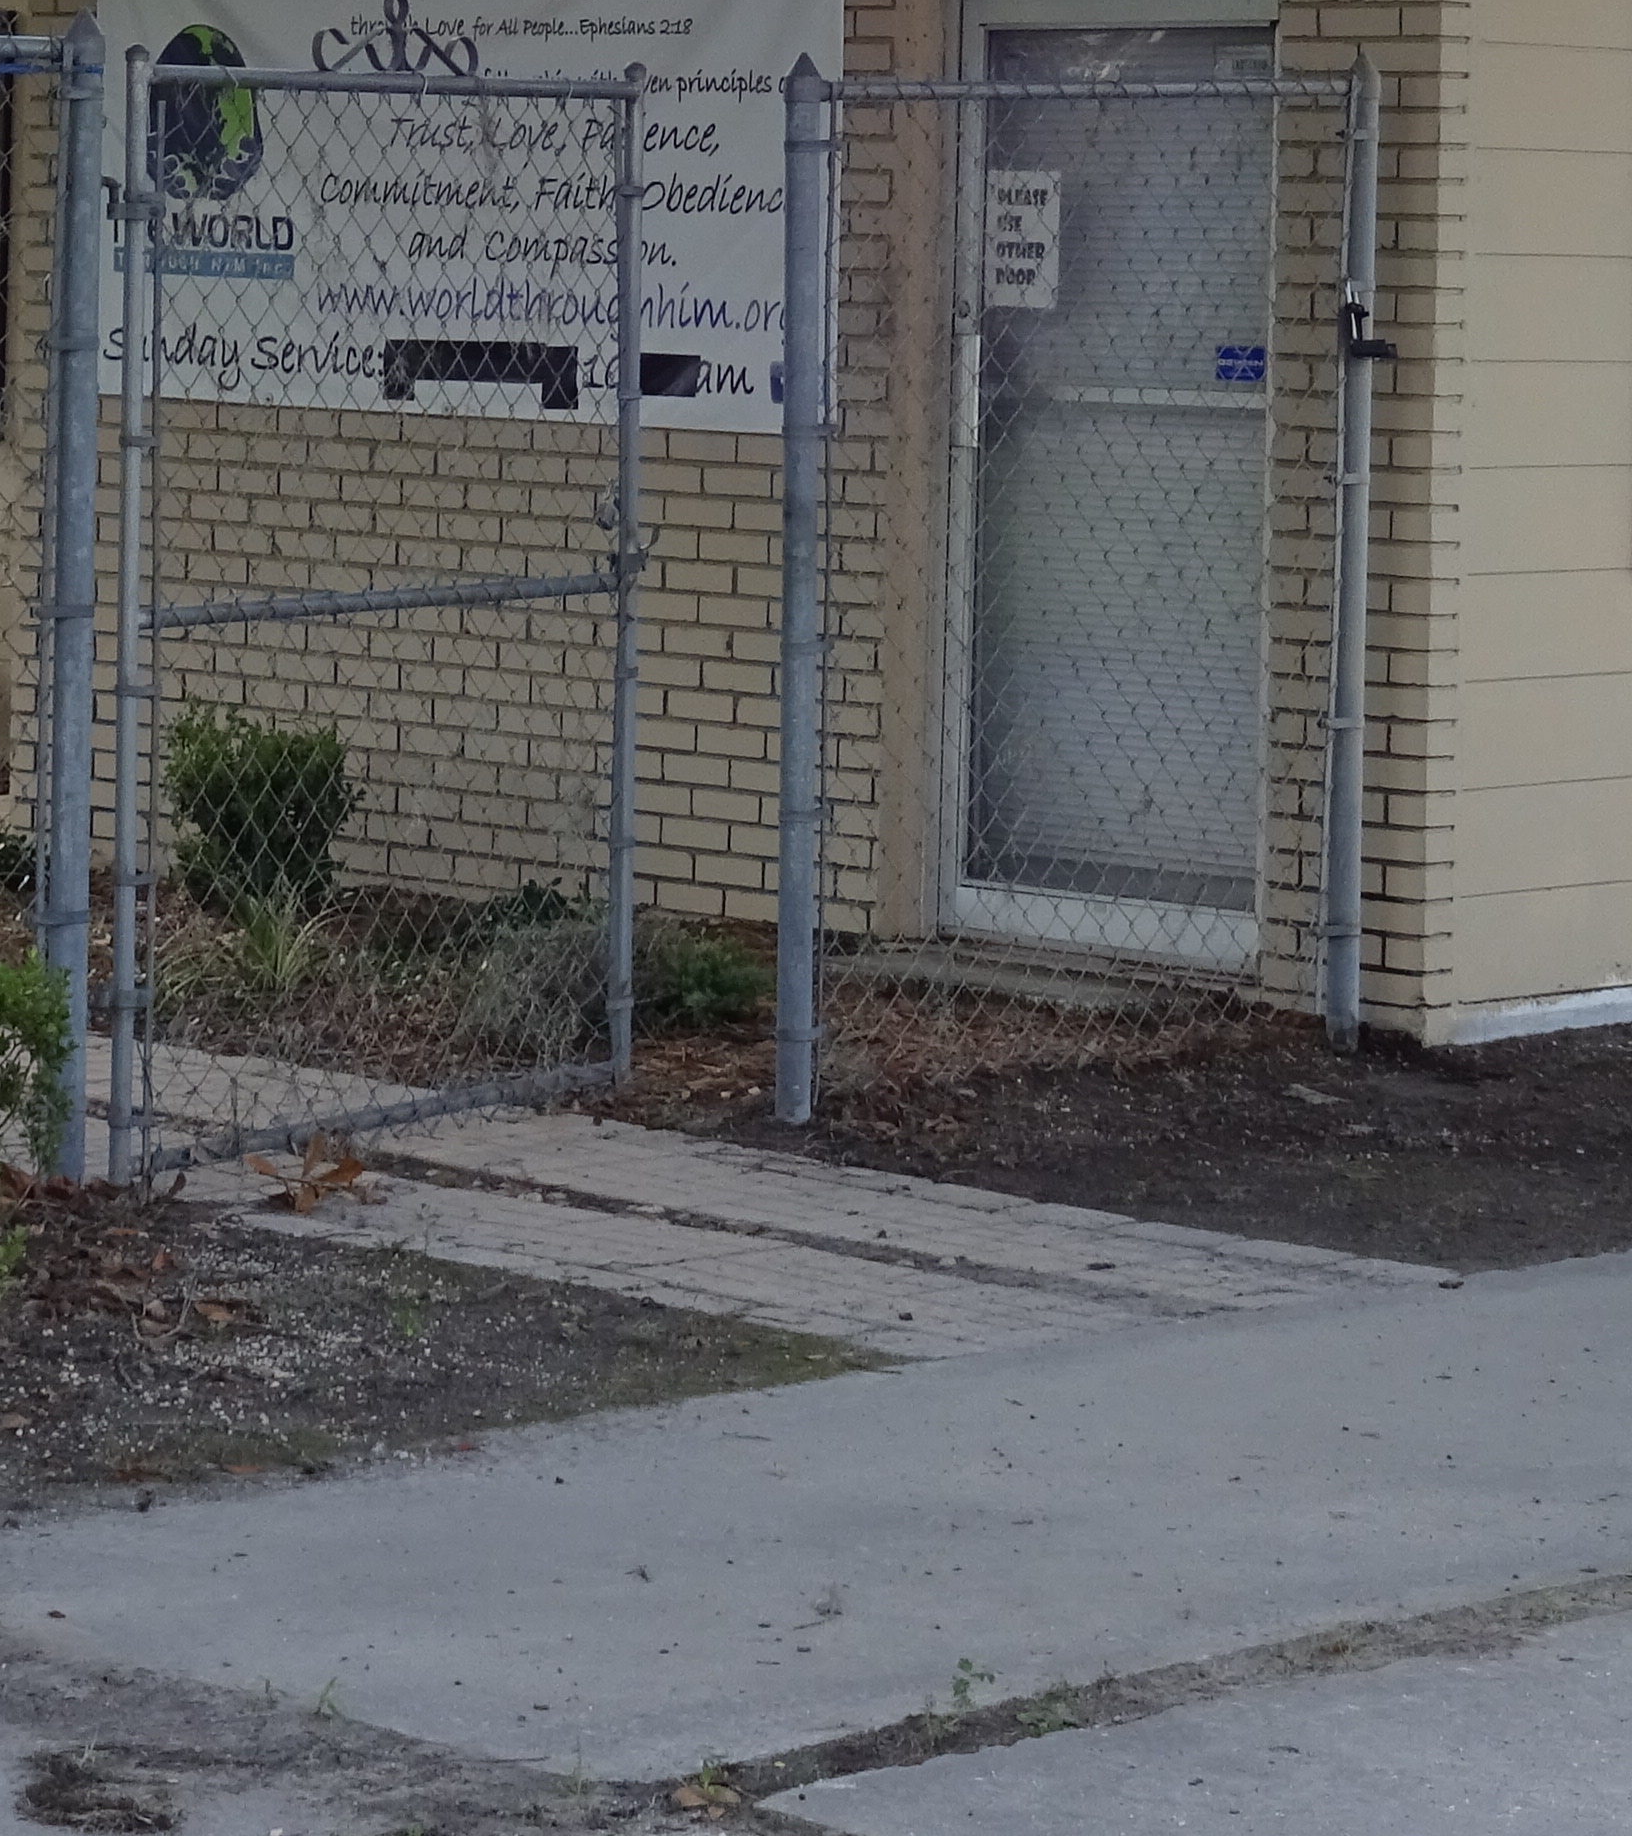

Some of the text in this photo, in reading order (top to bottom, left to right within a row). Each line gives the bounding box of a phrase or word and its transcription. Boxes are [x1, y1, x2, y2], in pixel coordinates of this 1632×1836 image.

[426, 17, 465, 35] Love
[472, 16, 493, 41] for
[496, 15, 518, 35] All
[678, 69, 772, 103] principles
[390, 116, 475, 154] Trust,
[582, 115, 720, 156] Paence,
[320, 168, 520, 213] Commitment,
[642, 172, 785, 214] Obedienc
[997, 188, 1048, 206] PLEASE
[171, 212, 294, 251] WORLD
[996, 241, 1045, 259] OTHER
[408, 224, 677, 281] and Compassn.
[251, 331, 385, 378] Service:
